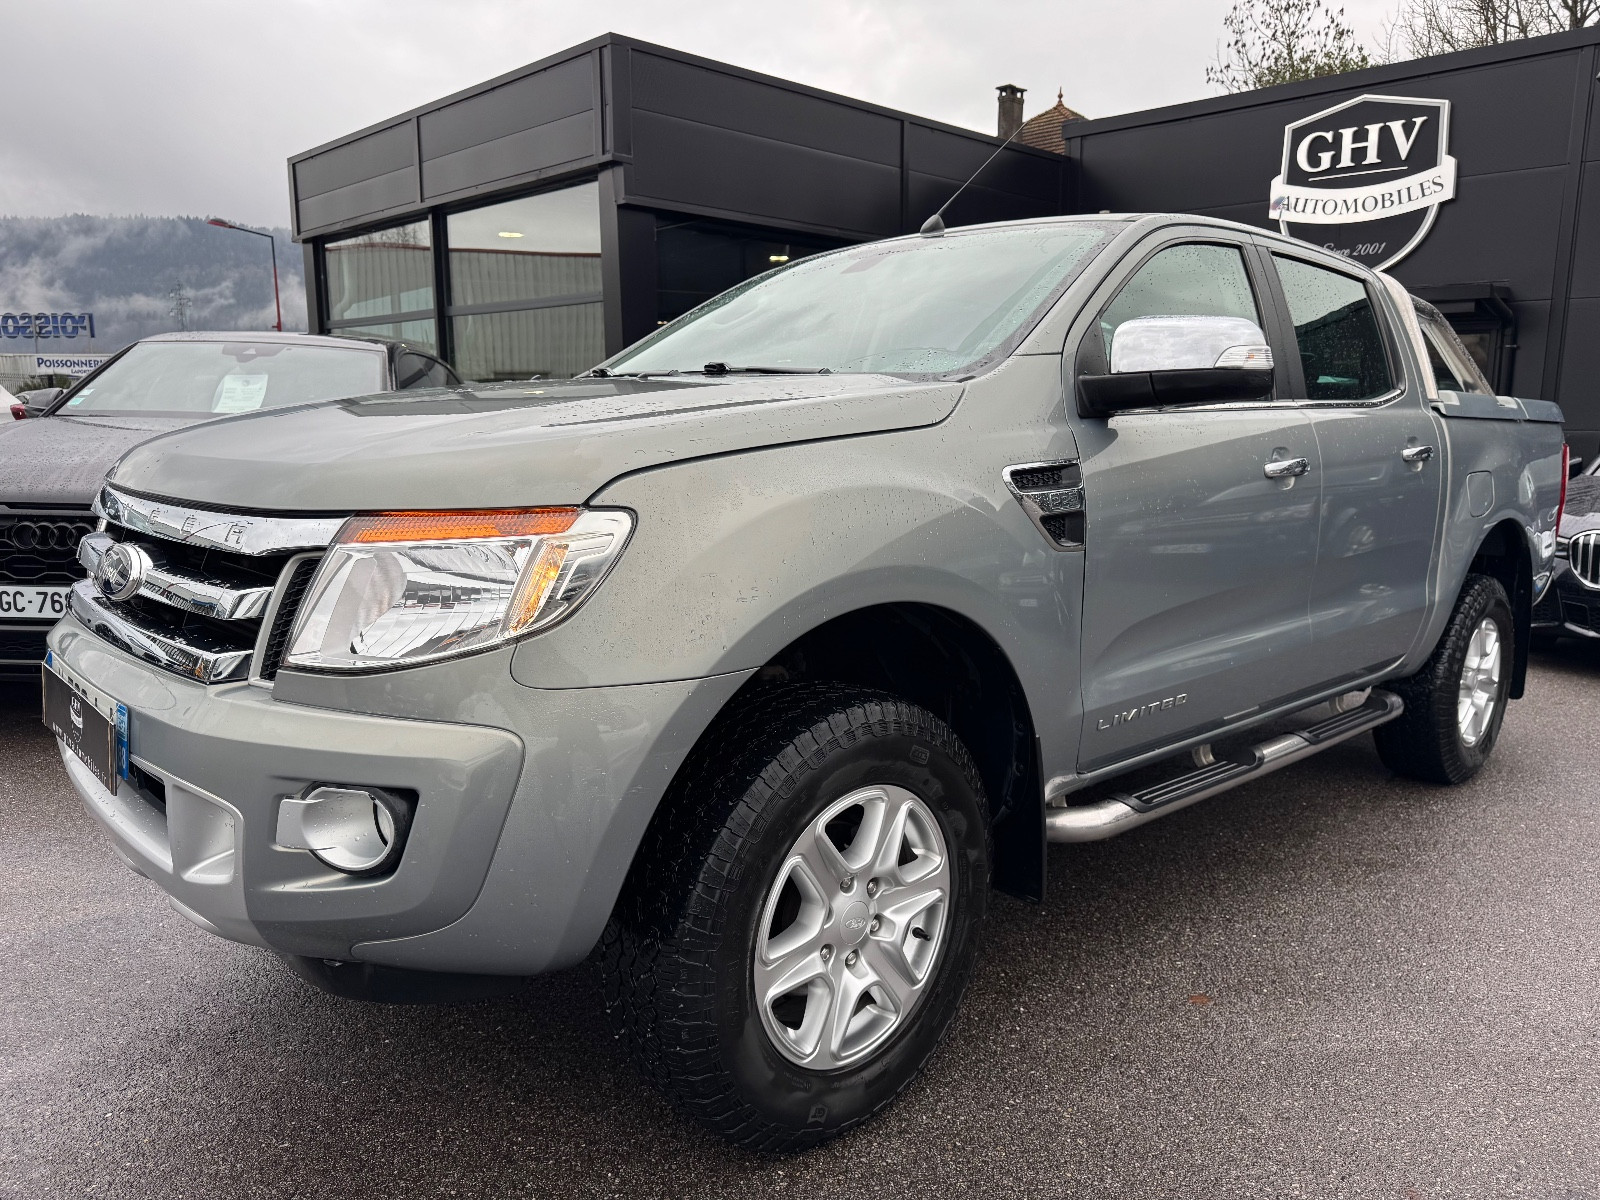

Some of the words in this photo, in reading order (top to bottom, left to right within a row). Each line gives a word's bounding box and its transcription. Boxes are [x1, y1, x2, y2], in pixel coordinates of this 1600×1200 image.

[1297, 116, 1428, 173] GHV
[1280, 175, 1445, 216] AUTOMOBILES
[1352, 241, 1387, 256] 2001
[0, 592, 69, 614] GC-76
[1097, 693, 1188, 731] LIMITED
